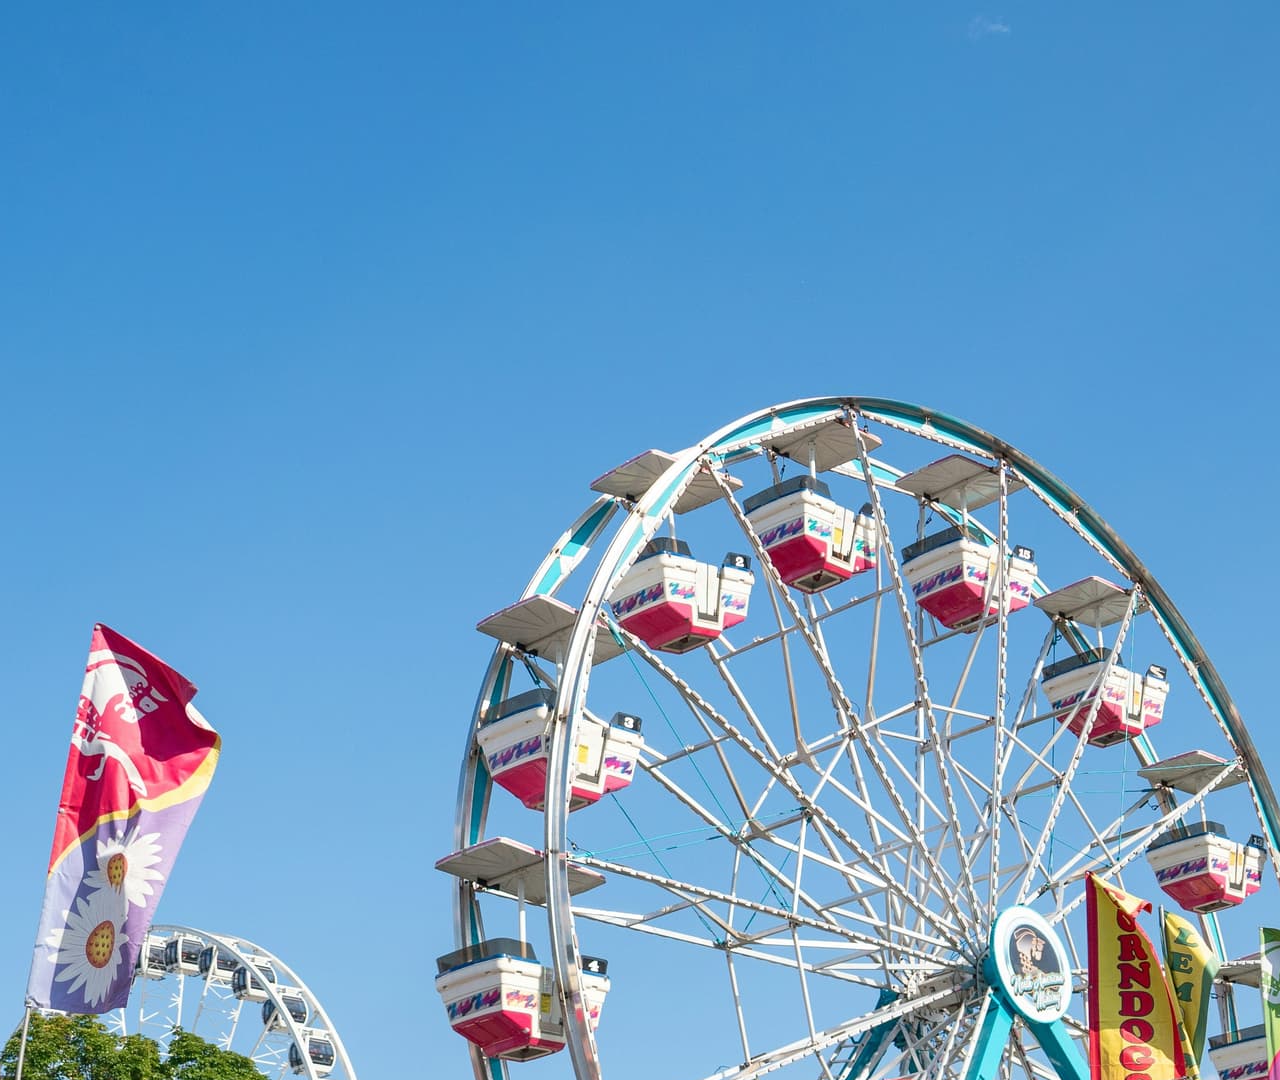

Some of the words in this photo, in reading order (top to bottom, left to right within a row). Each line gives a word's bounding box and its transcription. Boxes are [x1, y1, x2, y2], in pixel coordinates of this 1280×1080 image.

[735, 556, 745, 567] 2
[623, 718, 634, 729] 3
[587, 960, 600, 972] 4
